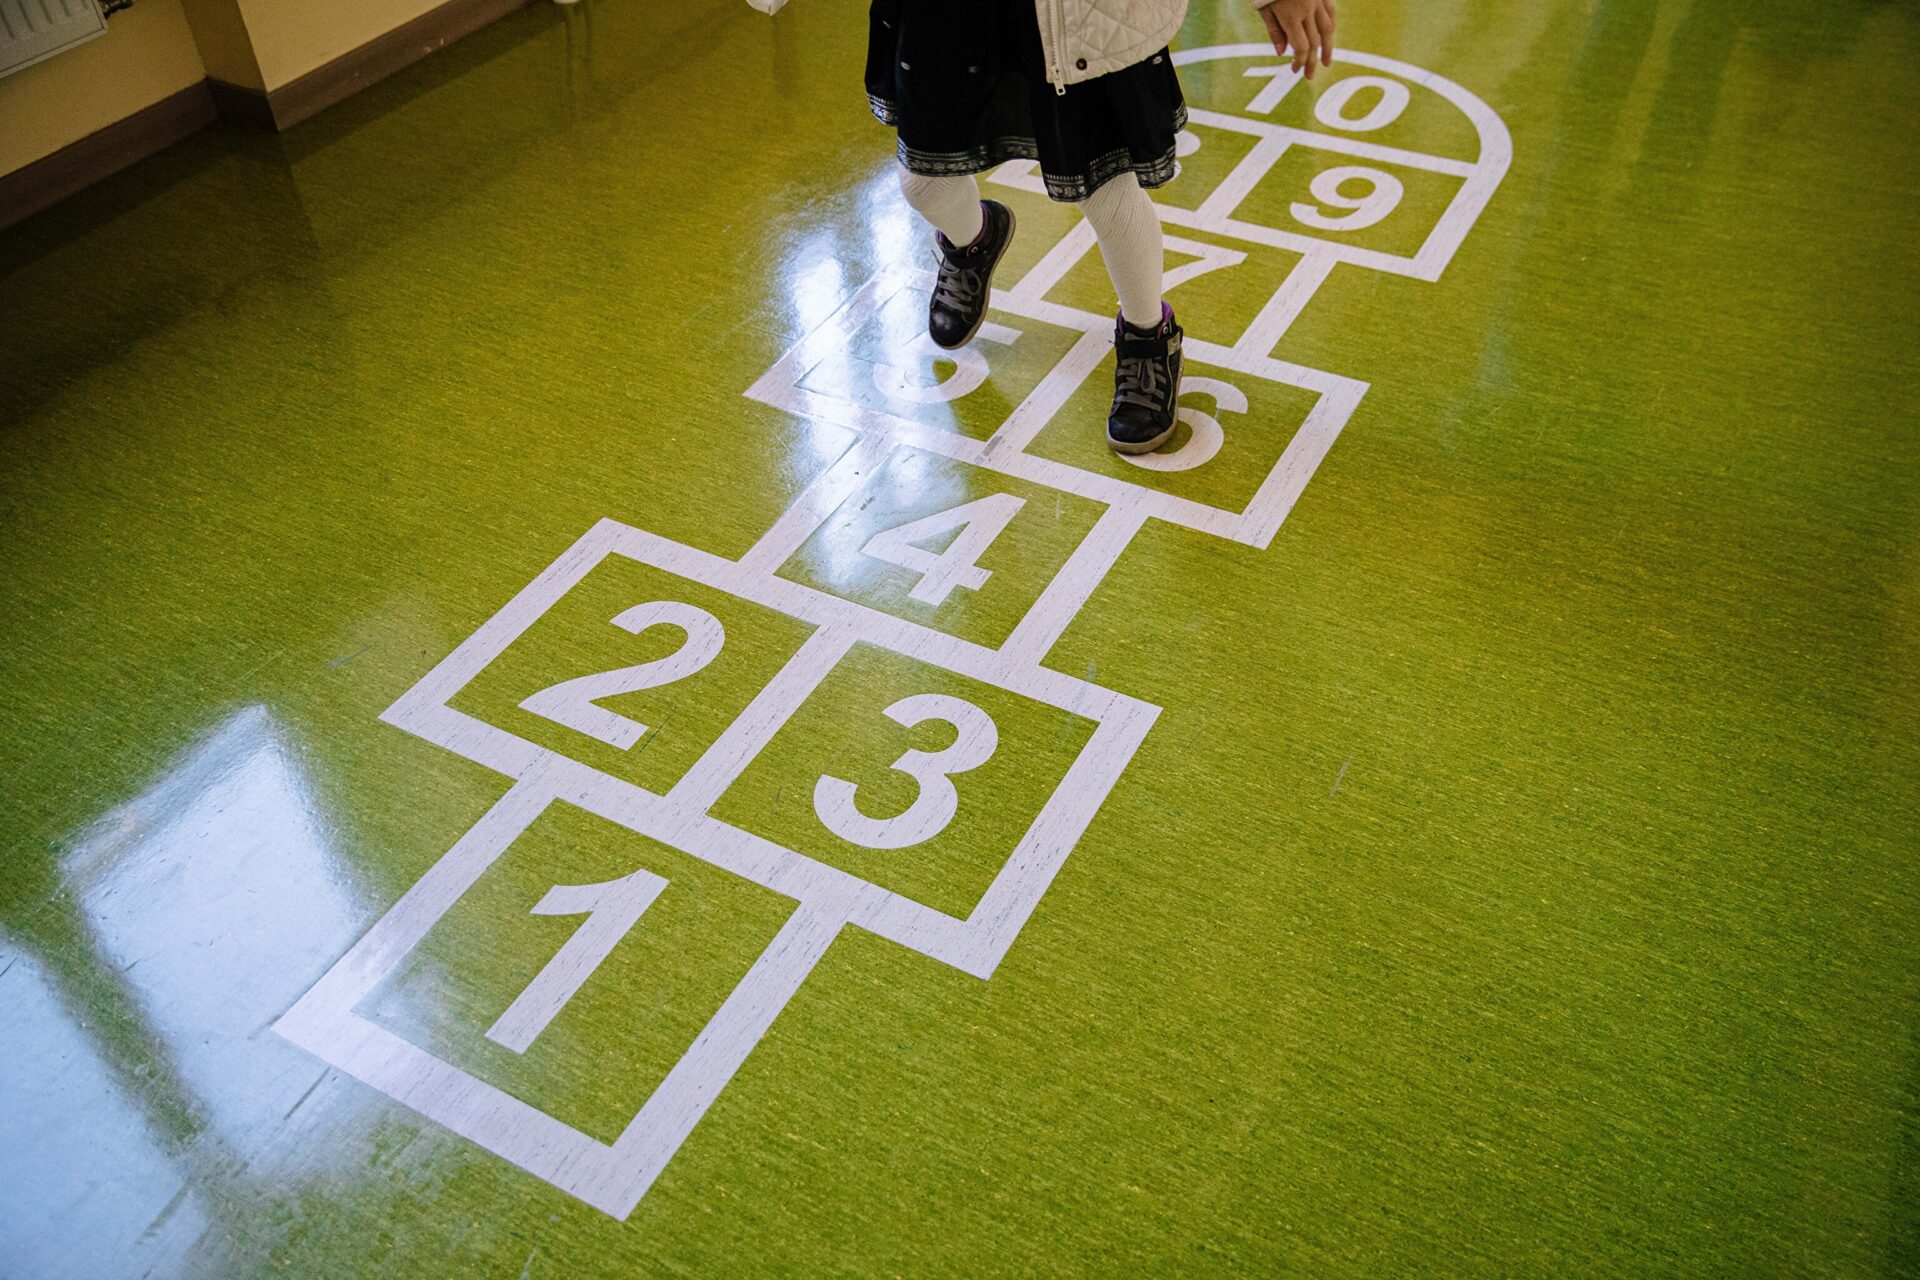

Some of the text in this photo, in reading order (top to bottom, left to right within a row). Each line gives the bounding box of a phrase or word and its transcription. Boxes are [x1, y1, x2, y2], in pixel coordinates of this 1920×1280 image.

[1242, 62, 1411, 132] 10
[1290, 166, 1404, 231] 9
[1115, 376, 1248, 472] 6
[860, 492, 1027, 605] 4
[518, 600, 725, 751] 2
[813, 693, 998, 850] 3
[484, 868, 670, 1055] 1
